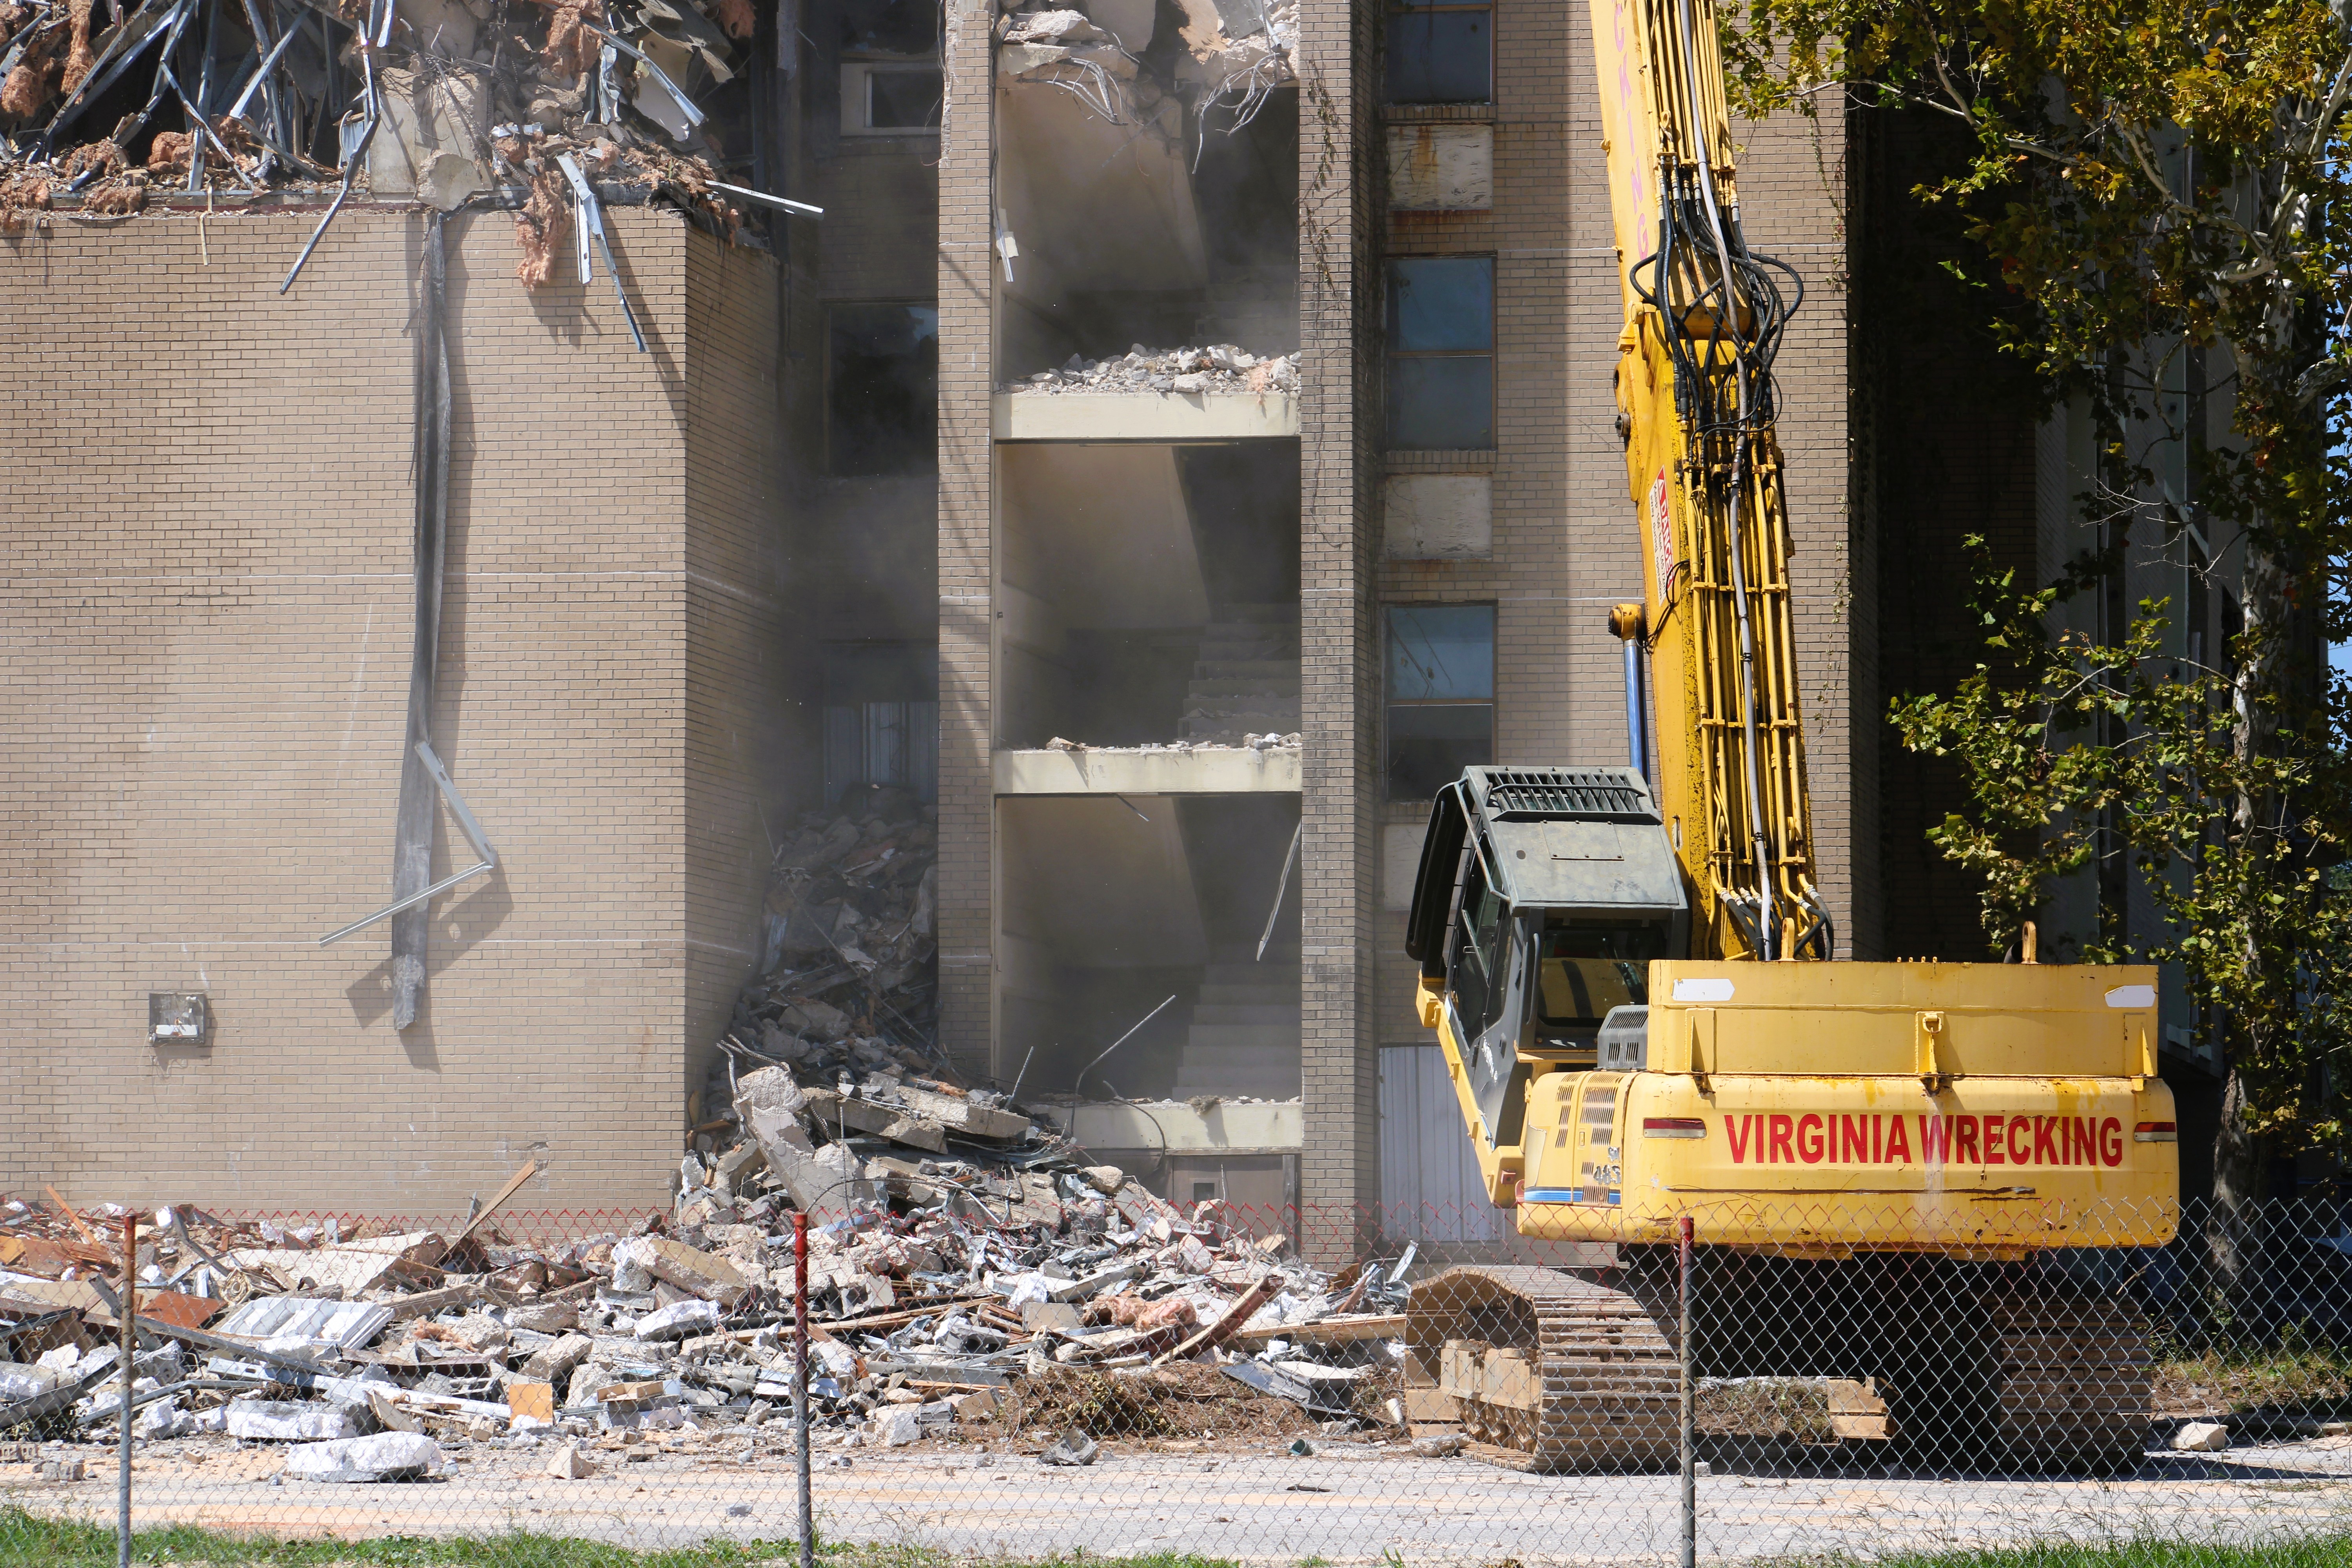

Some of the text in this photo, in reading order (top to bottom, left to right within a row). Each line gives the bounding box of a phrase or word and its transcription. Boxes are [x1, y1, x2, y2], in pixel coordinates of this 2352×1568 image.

[1612, 0, 1649, 261] CKING
[1661, 499, 1674, 584] DANGER
[1724, 1113, 2122, 1167] VIRGINIA WRECKING
